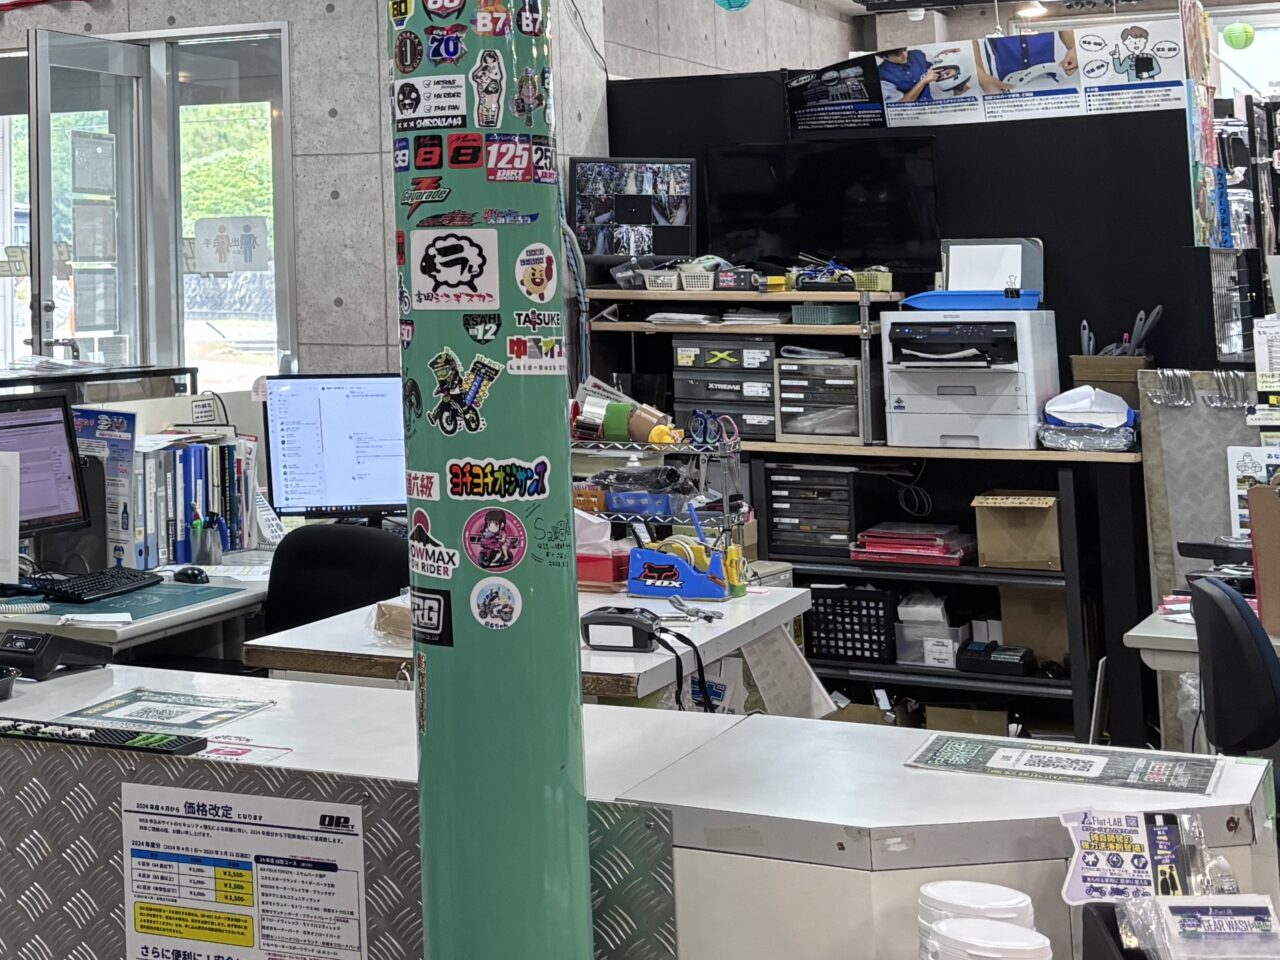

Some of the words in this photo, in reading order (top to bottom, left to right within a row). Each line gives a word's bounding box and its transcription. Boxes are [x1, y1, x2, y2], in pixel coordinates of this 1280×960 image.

[477, 12, 506, 32] B7
[416, 147, 441, 166] 8
[450, 146, 481, 164] 8
[487, 144, 530, 169] 125
[464, 314, 501, 326] ASAHI
[476, 324, 497, 340] 12
[421, 562, 450, 577] RIDER
[644, 577, 683, 588] FOX
[184, 801, 233, 819] 価格改定
[319, 815, 350, 827] OP
[1202, 920, 1225, 931] GEAR
[1227, 920, 1250, 932] WASH
